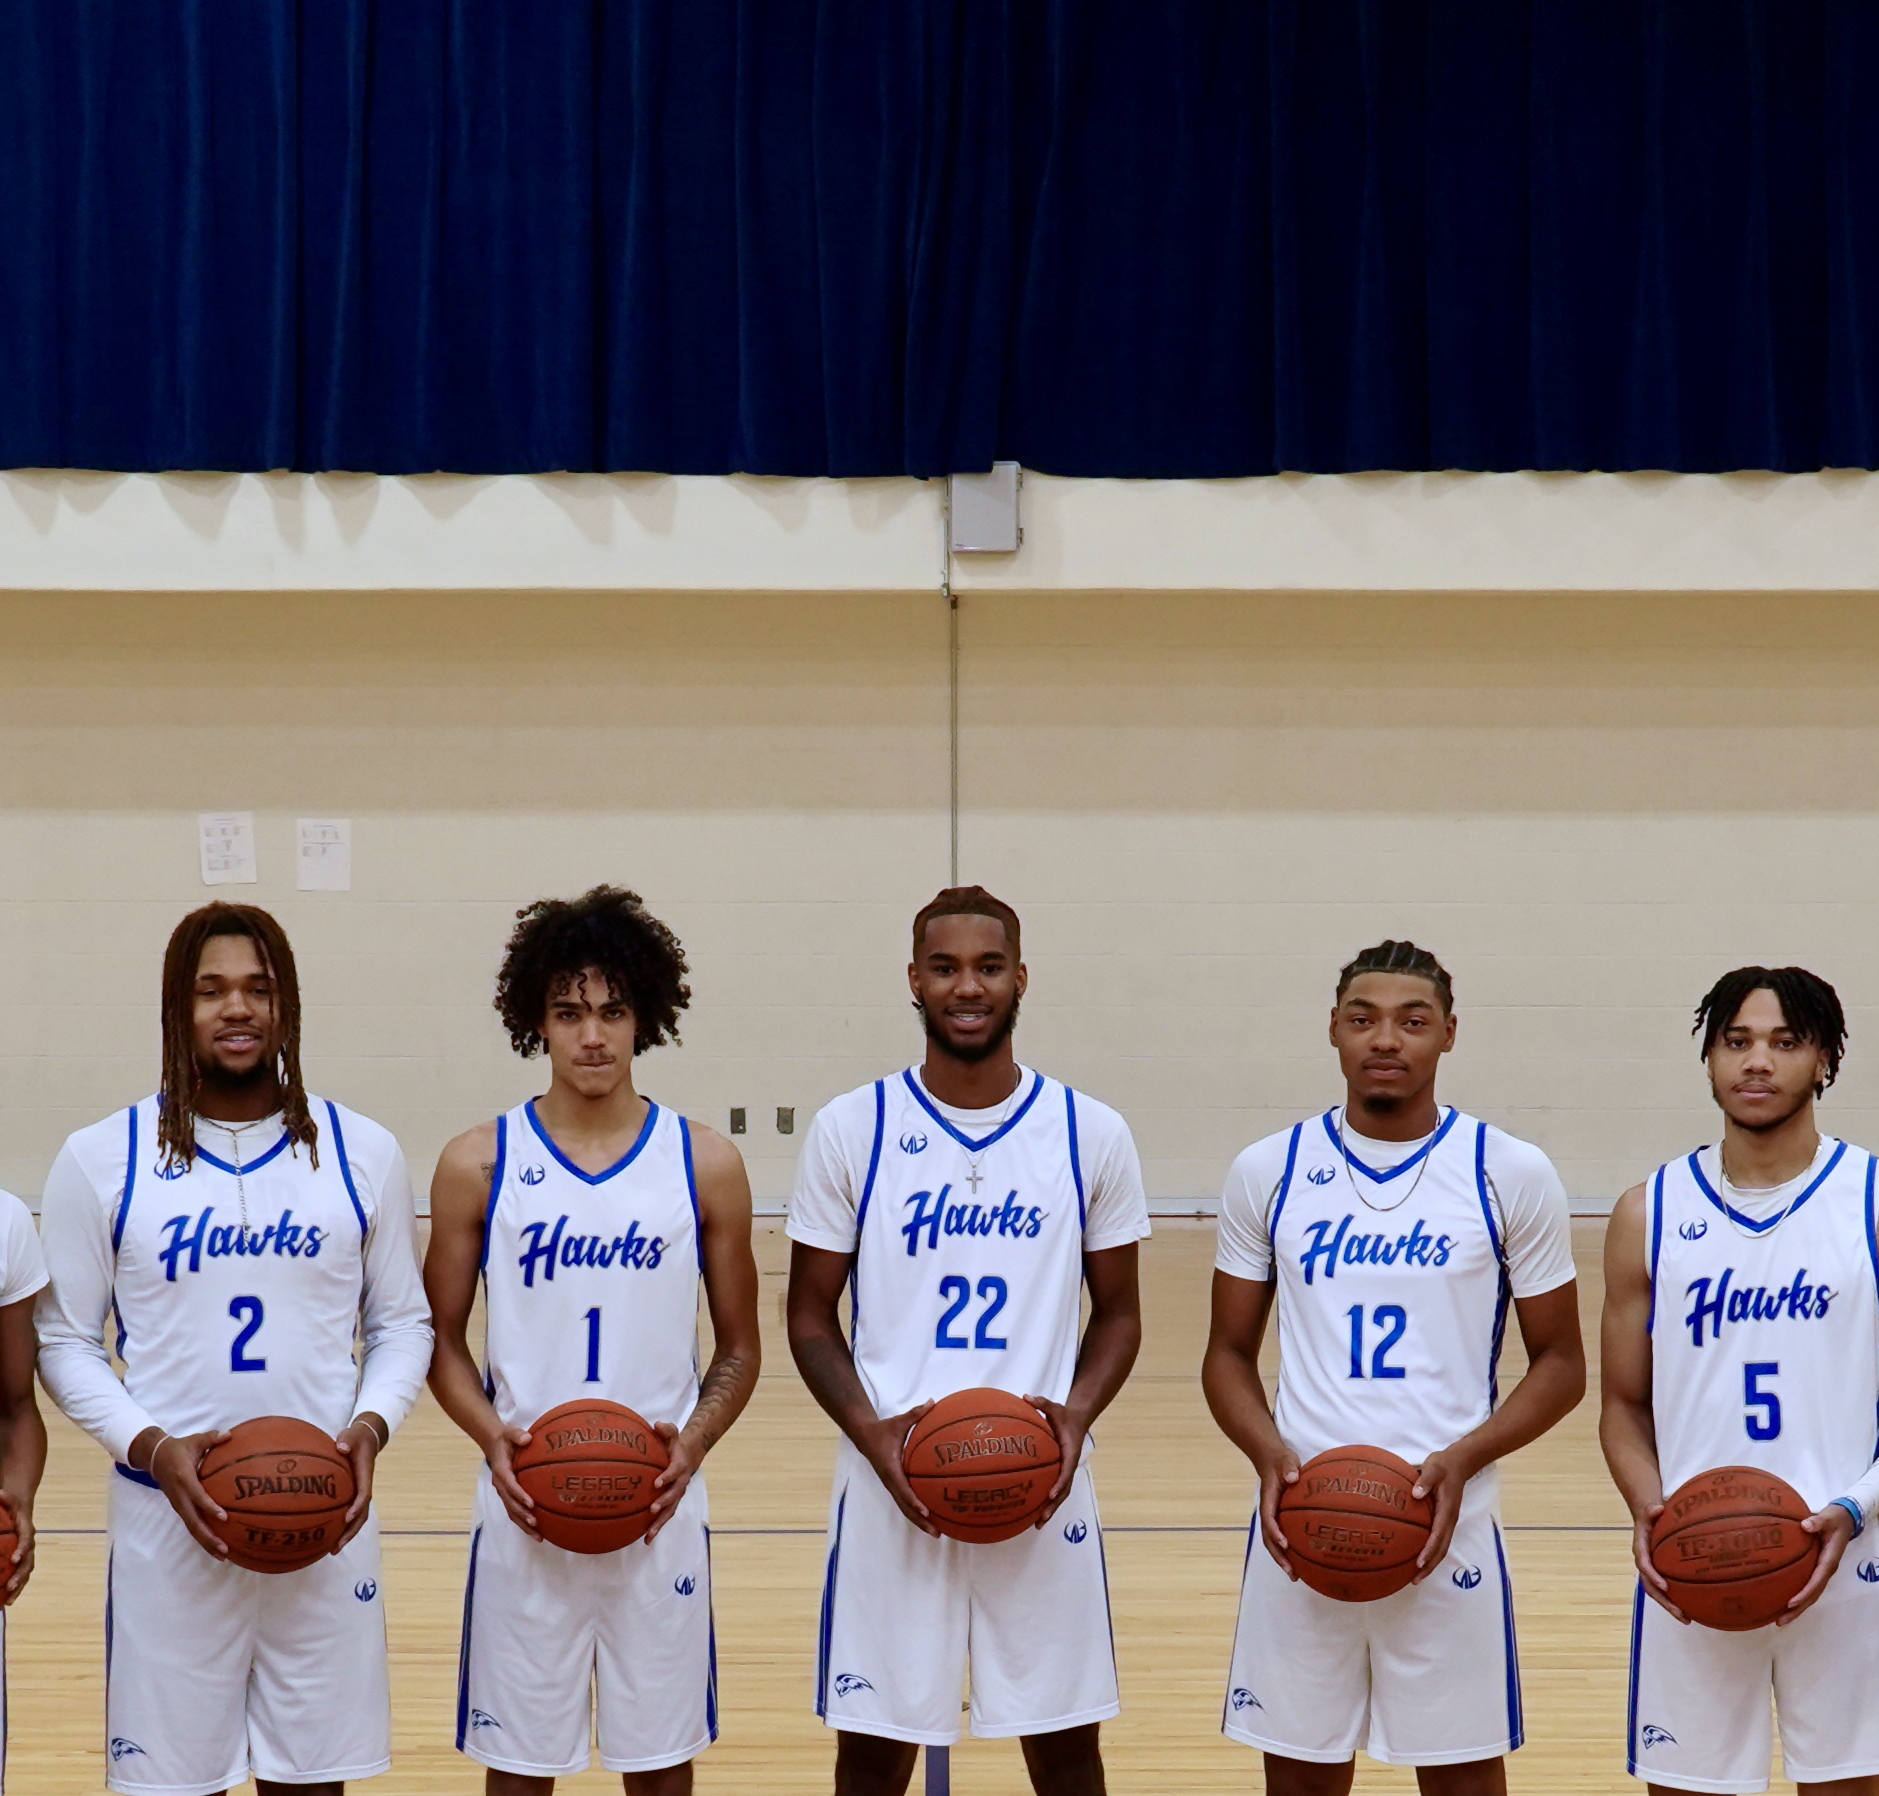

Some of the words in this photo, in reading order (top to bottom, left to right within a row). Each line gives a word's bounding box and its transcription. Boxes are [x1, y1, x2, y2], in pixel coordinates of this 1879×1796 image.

[158, 1206, 330, 1282] Hawks
[518, 1215, 669, 1288] Hawks
[901, 1183, 1050, 1257] Hawks
[1299, 1214, 1458, 1285] Hawks
[227, 1294, 267, 1374] 2
[934, 1274, 1009, 1351] 22
[1345, 1303, 1408, 1380] 12
[1685, 1267, 1836, 1348] Hawks
[581, 1306, 602, 1383] 1
[1742, 1361, 1783, 1443] 5
[544, 1427, 647, 1456] SPALDING
[934, 1435, 1037, 1468] SPALDING
[234, 1474, 337, 1500] SPALDING
[551, 1475, 643, 1491] LEGACY
[1305, 1477, 1408, 1511] SPALDING
[1303, 1521, 1395, 1545] LEGACY
